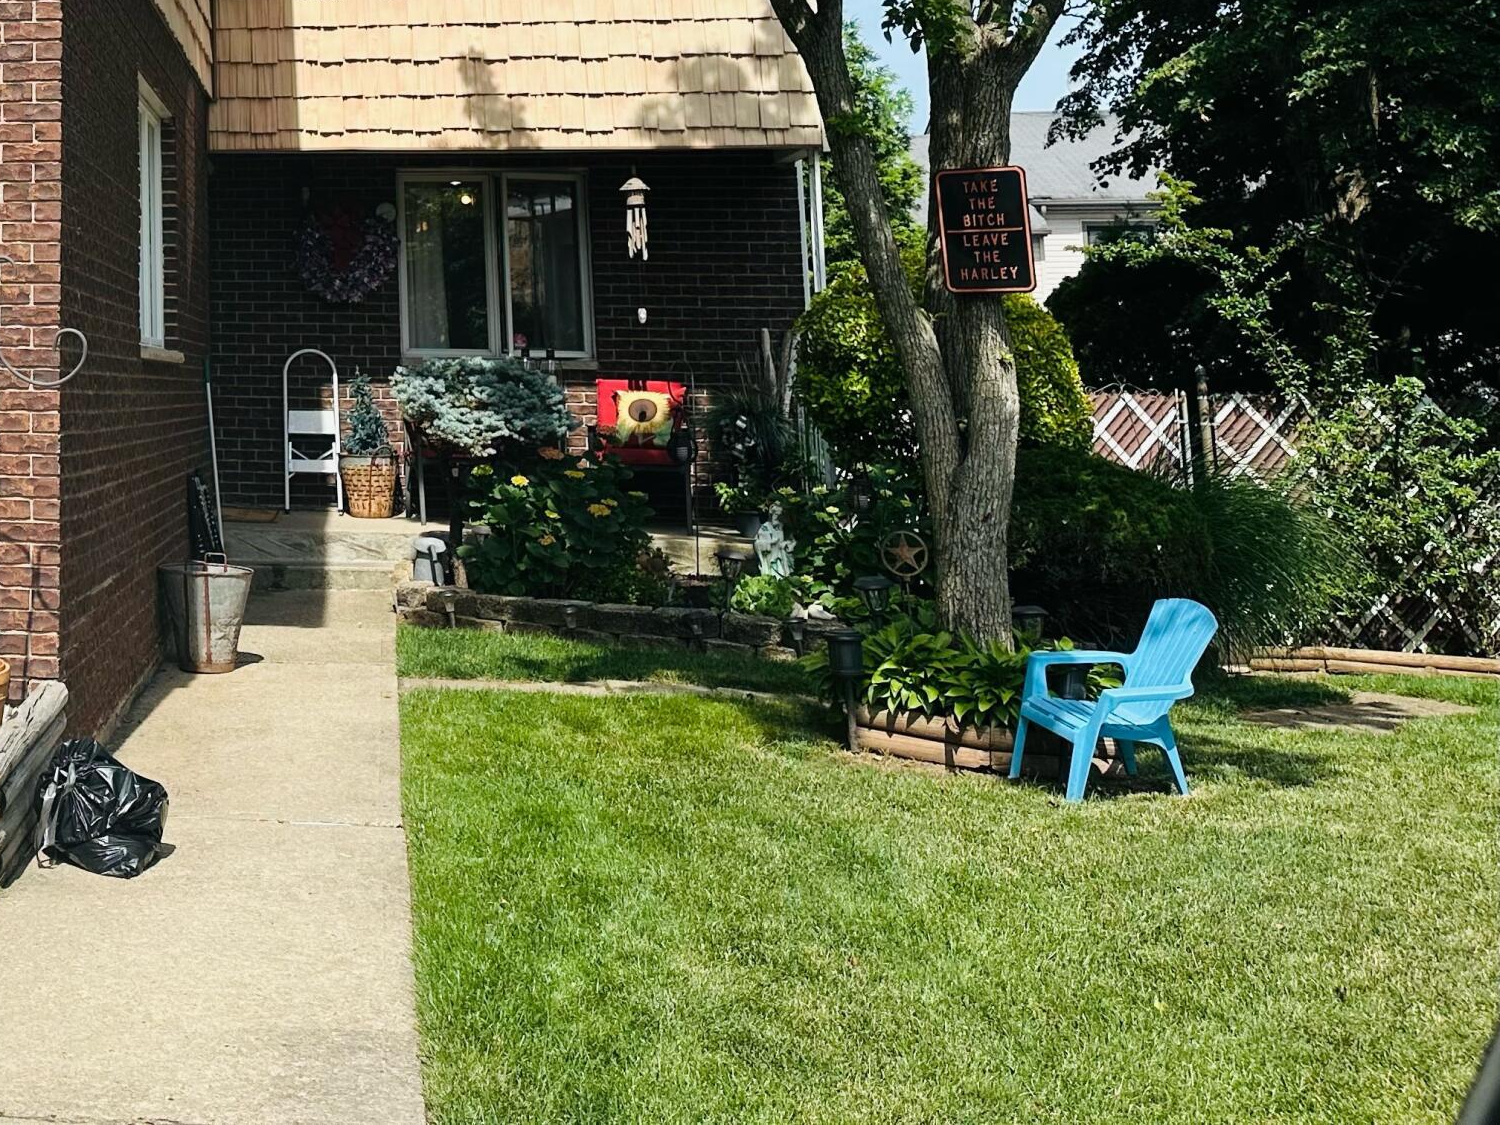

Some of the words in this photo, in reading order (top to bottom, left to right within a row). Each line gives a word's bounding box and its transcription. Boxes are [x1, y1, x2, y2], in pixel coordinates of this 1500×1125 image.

[962, 178, 999, 194] TAKE
[968, 196, 996, 210] THE
[962, 212, 1005, 228] BITCH
[963, 232, 1009, 247] LEAVE
[974, 250, 1001, 264] THE
[959, 266, 1019, 281] HARLEY
